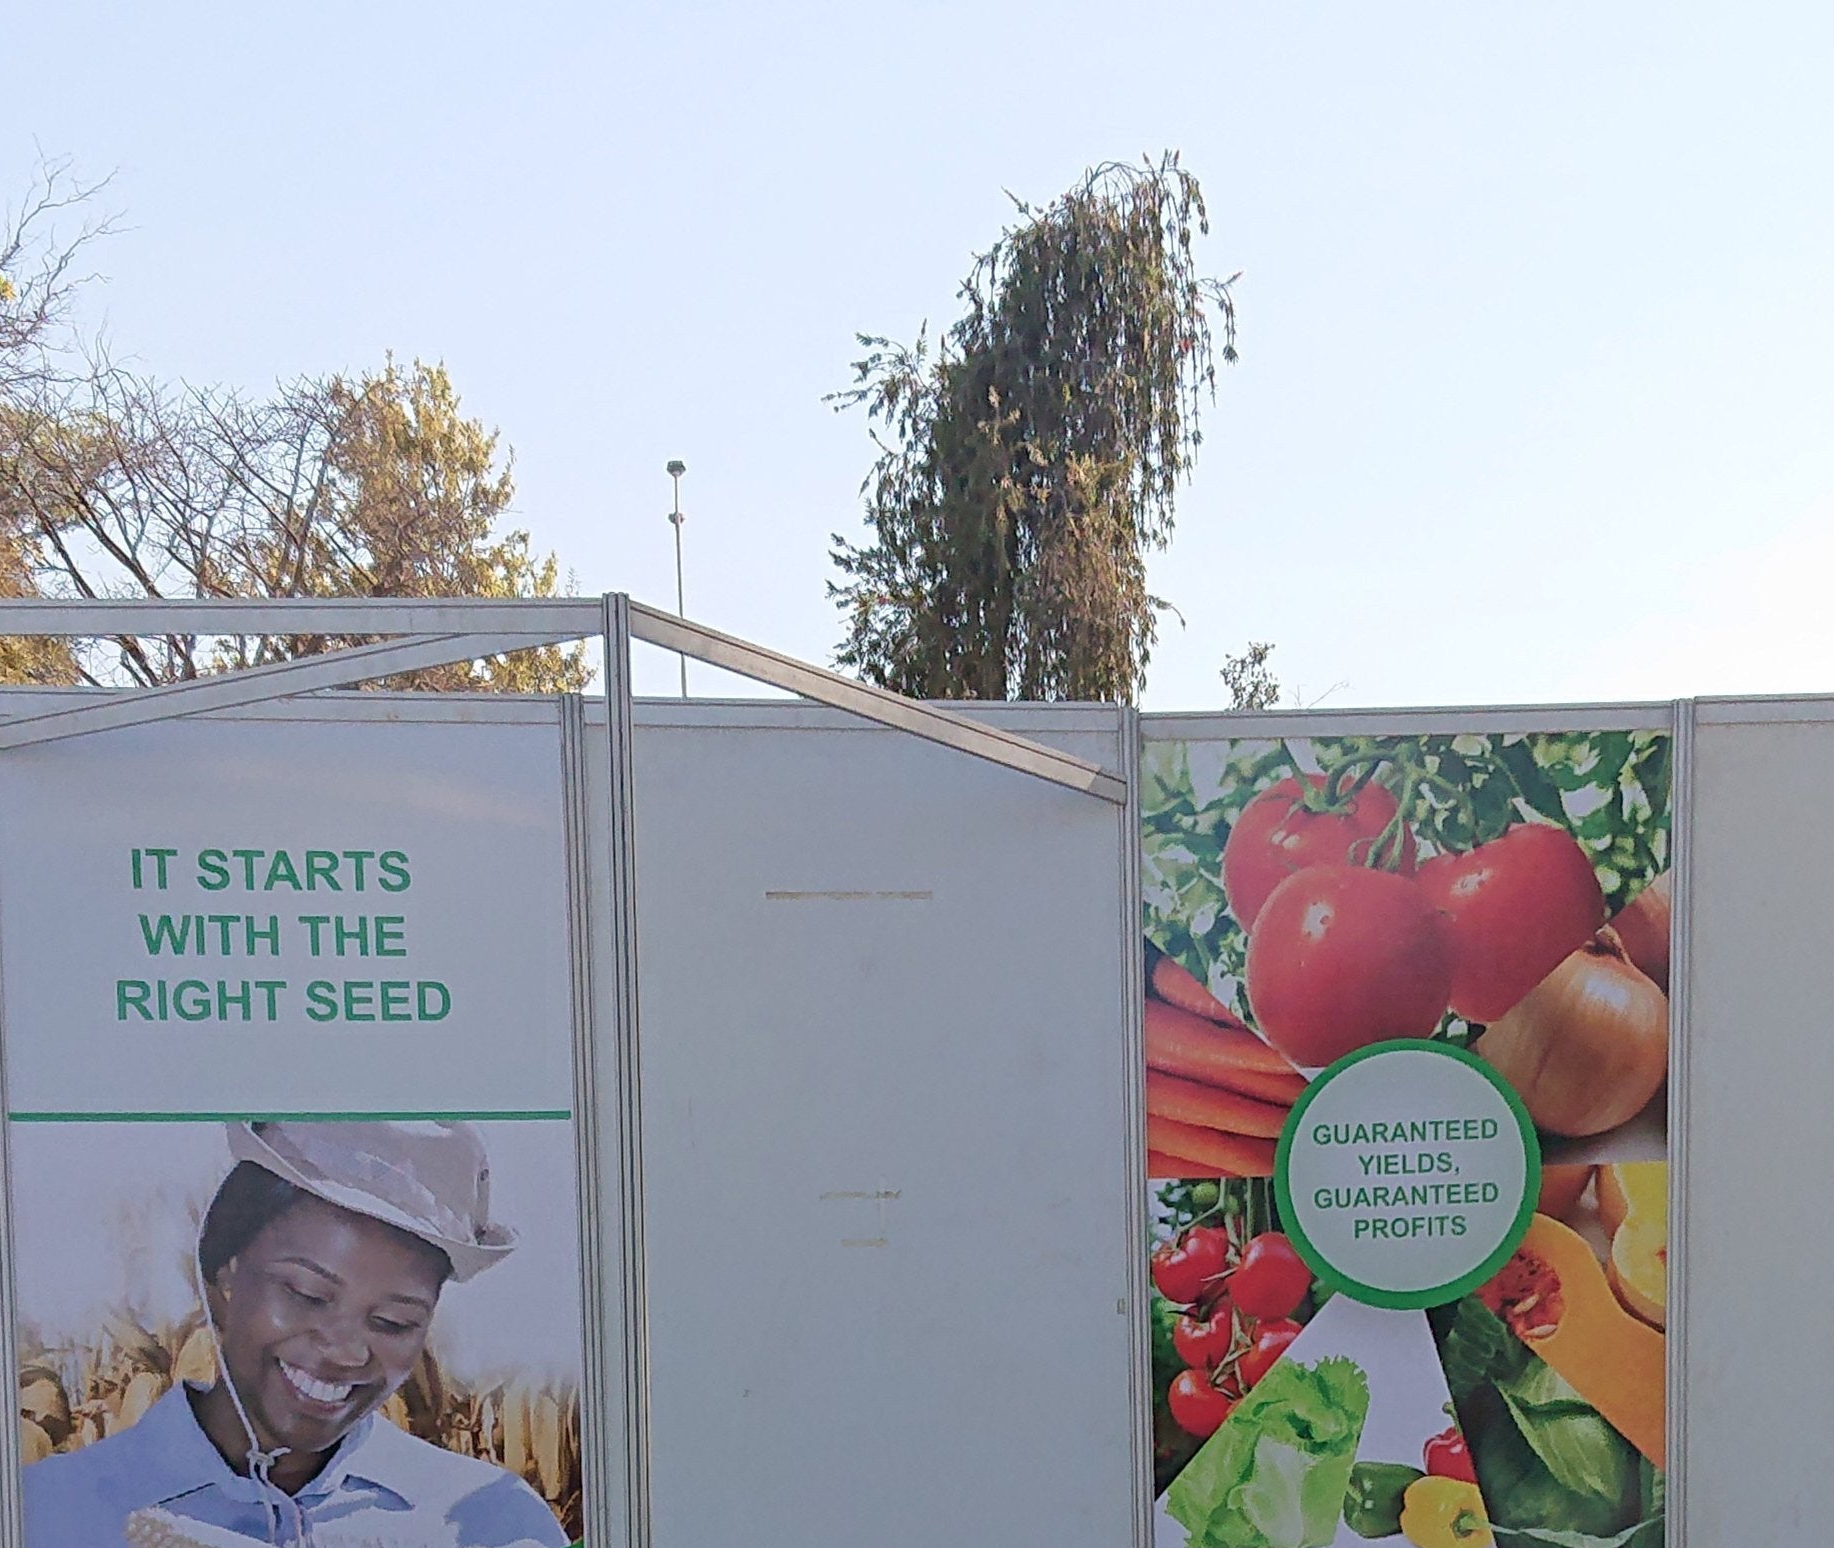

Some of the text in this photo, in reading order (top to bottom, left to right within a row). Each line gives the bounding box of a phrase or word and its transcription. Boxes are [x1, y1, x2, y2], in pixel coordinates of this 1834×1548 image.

[131, 848, 411, 892] IT STARTS
[139, 915, 406, 957] WITH THE
[117, 980, 451, 1021] RIGHT SEED
[1312, 1119, 1498, 1145] GUARANTEED
[1358, 1153, 1460, 1176] YIELDS,
[1314, 1182, 1499, 1209] GUARANTEED
[1354, 1216, 1467, 1239] PROFITS
